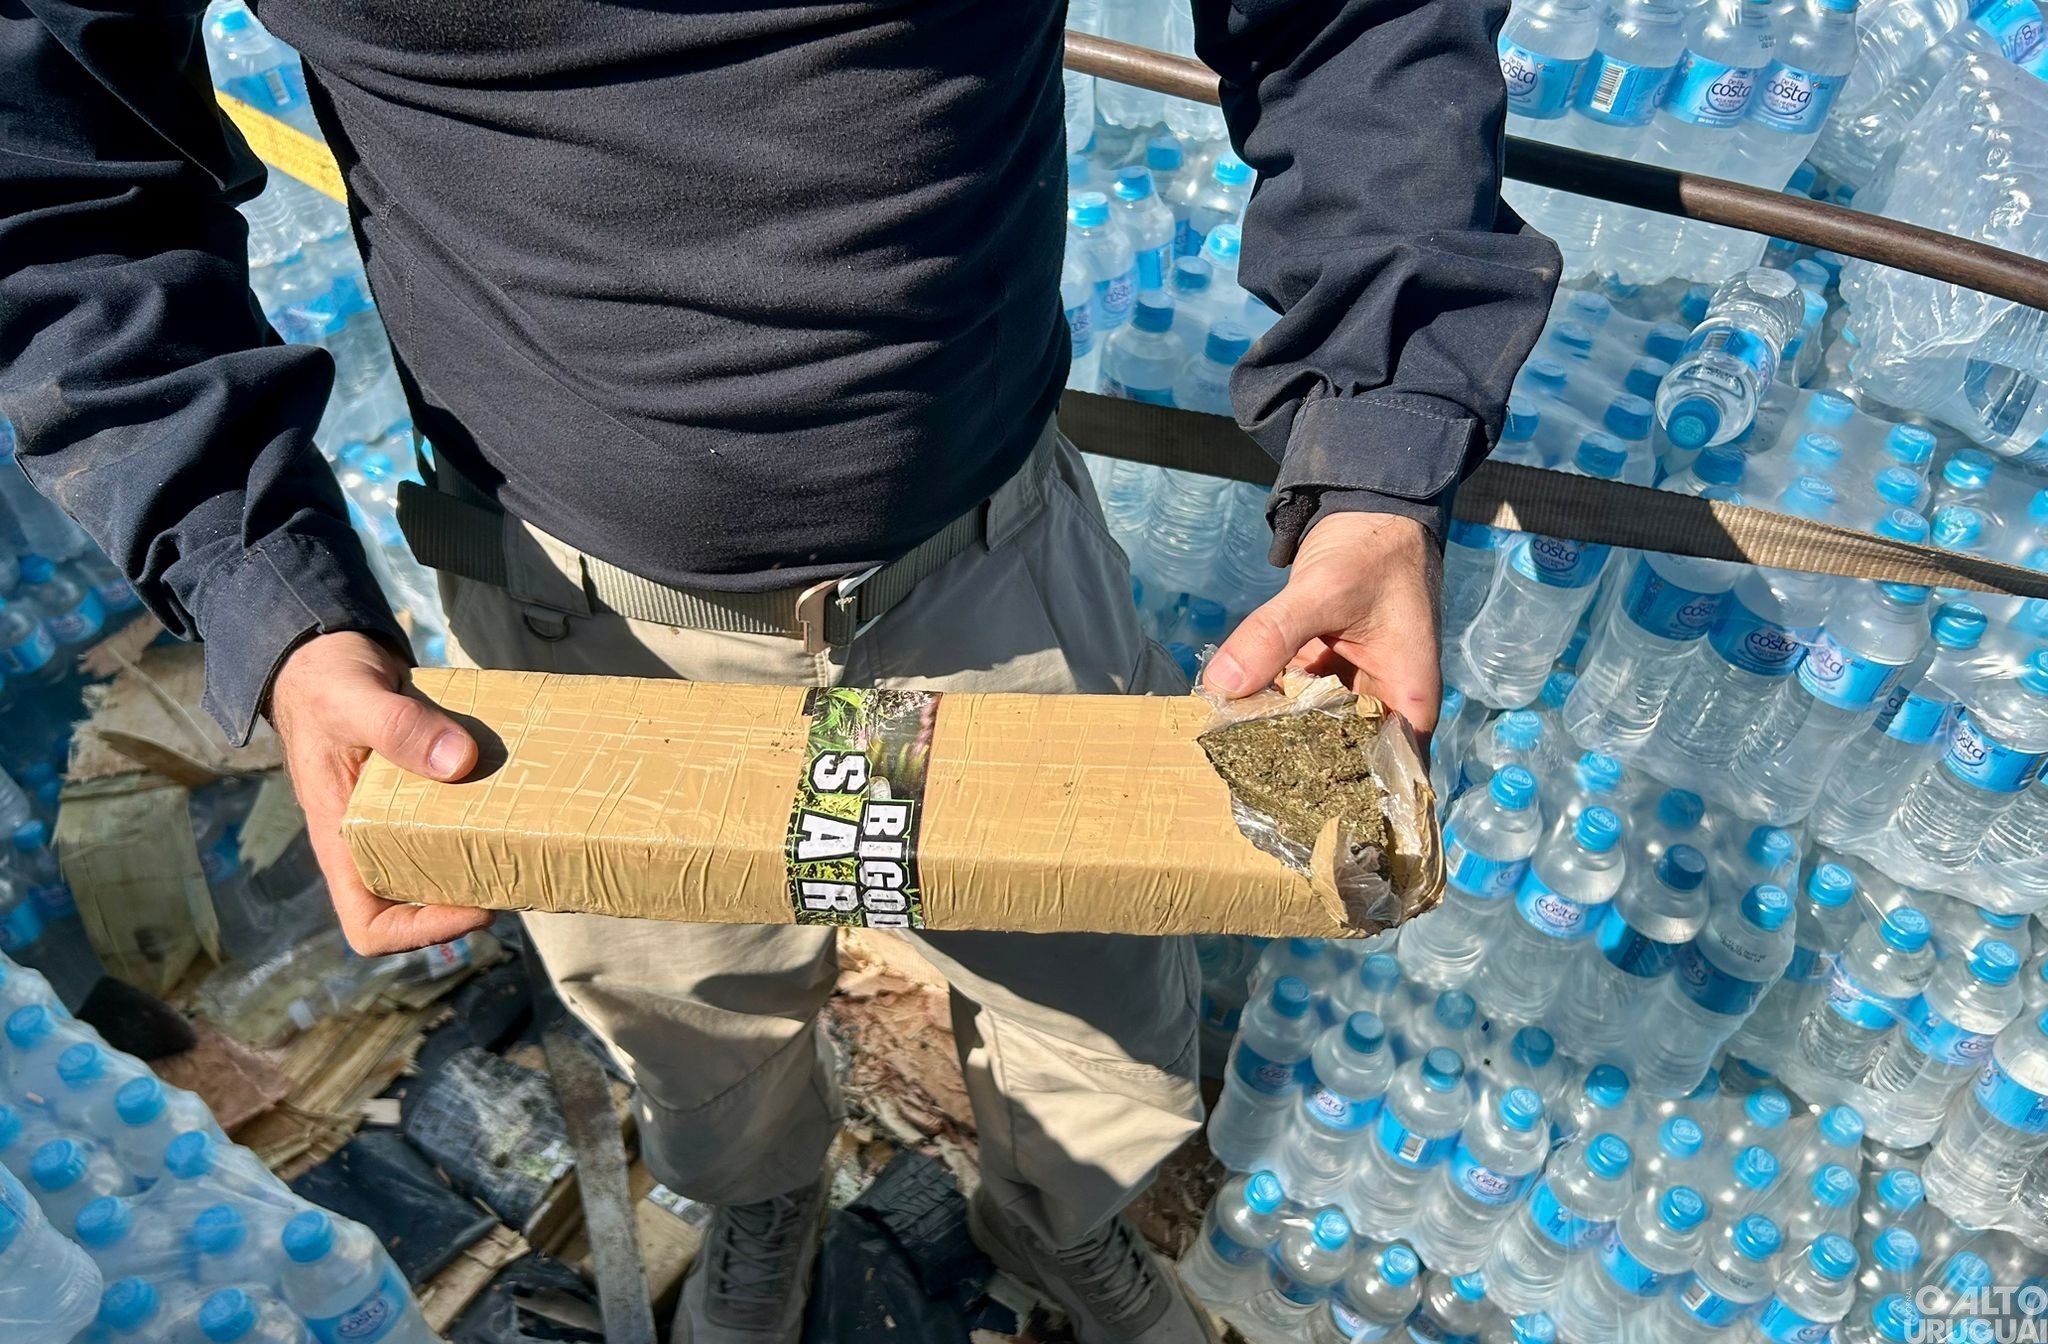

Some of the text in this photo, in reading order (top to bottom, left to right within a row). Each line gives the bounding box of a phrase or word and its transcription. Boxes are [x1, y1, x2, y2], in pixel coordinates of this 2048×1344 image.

[1766, 80, 1812, 104] costa
[1532, 539, 1578, 563] costa
[1749, 632, 1800, 652] costa
